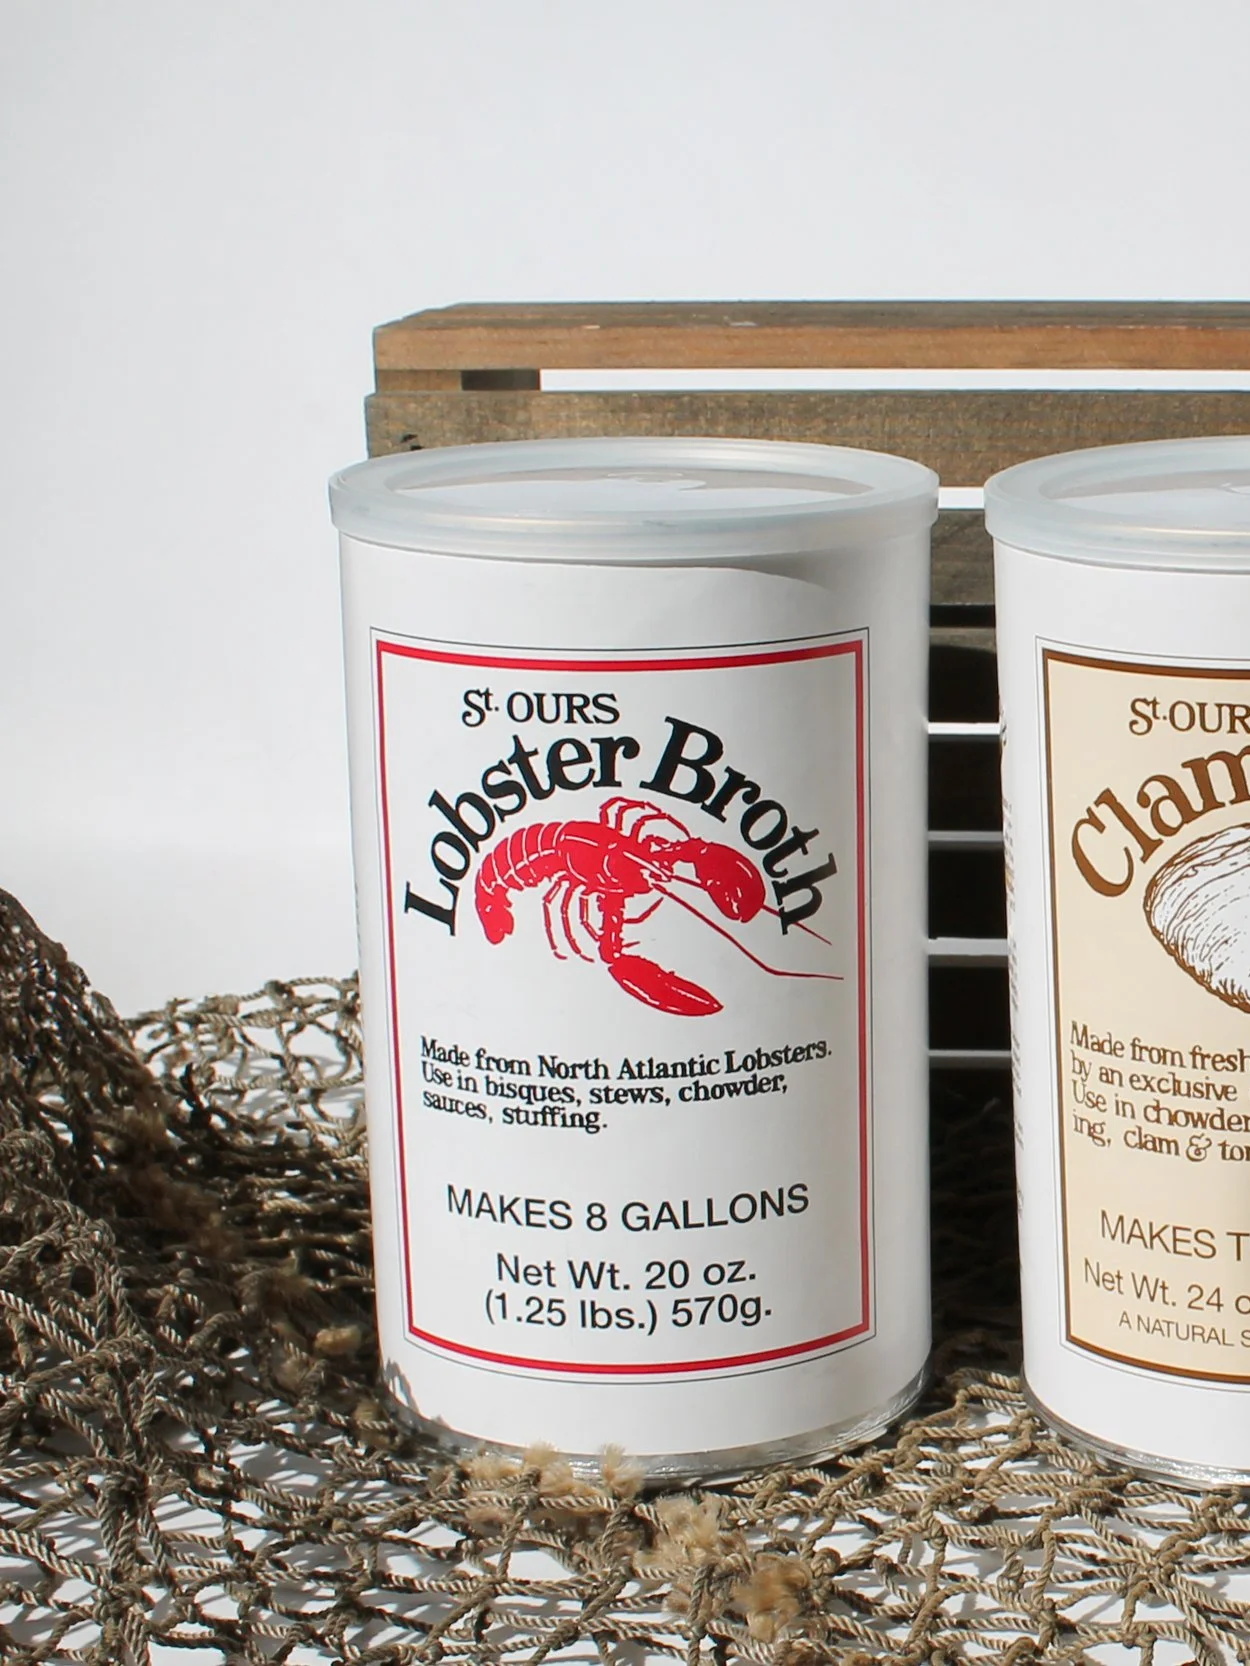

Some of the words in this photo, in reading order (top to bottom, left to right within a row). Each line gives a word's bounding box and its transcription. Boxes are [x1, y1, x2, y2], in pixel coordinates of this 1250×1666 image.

[507, 692, 620, 724] OURS
[404, 734, 640, 936] Lobster
[640, 716, 838, 935] Broth
[420, 1036, 471, 1067] Made
[475, 1048, 531, 1076] from
[538, 1055, 609, 1080] North
[617, 1053, 720, 1080] Atlantic
[725, 1038, 832, 1075] Lobsters.
[1071, 1020, 1125, 1057] Made
[1130, 1038, 1184, 1068] from
[422, 1063, 453, 1087] Use
[456, 1067, 478, 1093] in
[486, 1077, 582, 1105] bisques,
[589, 1083, 671, 1106] stews,
[678, 1072, 788, 1101] chowder,
[1072, 1051, 1092, 1082] by
[1099, 1066, 1124, 1086] an
[1130, 1072, 1237, 1102] exclusive
[423, 1090, 493, 1123] sauces,
[502, 1104, 608, 1134] stuffing.
[1072, 1081, 1107, 1112] Use
[1115, 1097, 1135, 1118] in
[1072, 1111, 1112, 1148] ing,
[1124, 1126, 1180, 1156] clam
[447, 1184, 572, 1230] MAKES
[587, 1203, 607, 1231] 8
[621, 1183, 809, 1232] GALLONS
[1100, 1210, 1217, 1259] MAKES
[497, 1253, 556, 1287] Net
[568, 1261, 630, 1291] Wt.
[645, 1261, 689, 1290] 20
[703, 1259, 756, 1286] oz.
[1084, 1258, 1124, 1295] Net
[1130, 1275, 1176, 1307] Wt.
[1187, 1284, 1224, 1313] 24
[485, 1289, 566, 1327] (1.25
[581, 1300, 657, 1335] lbs.)
[671, 1294, 772, 1328] 570g.
[1118, 1311, 1132, 1329] A
[1136, 1316, 1234, 1348] NATURAL
